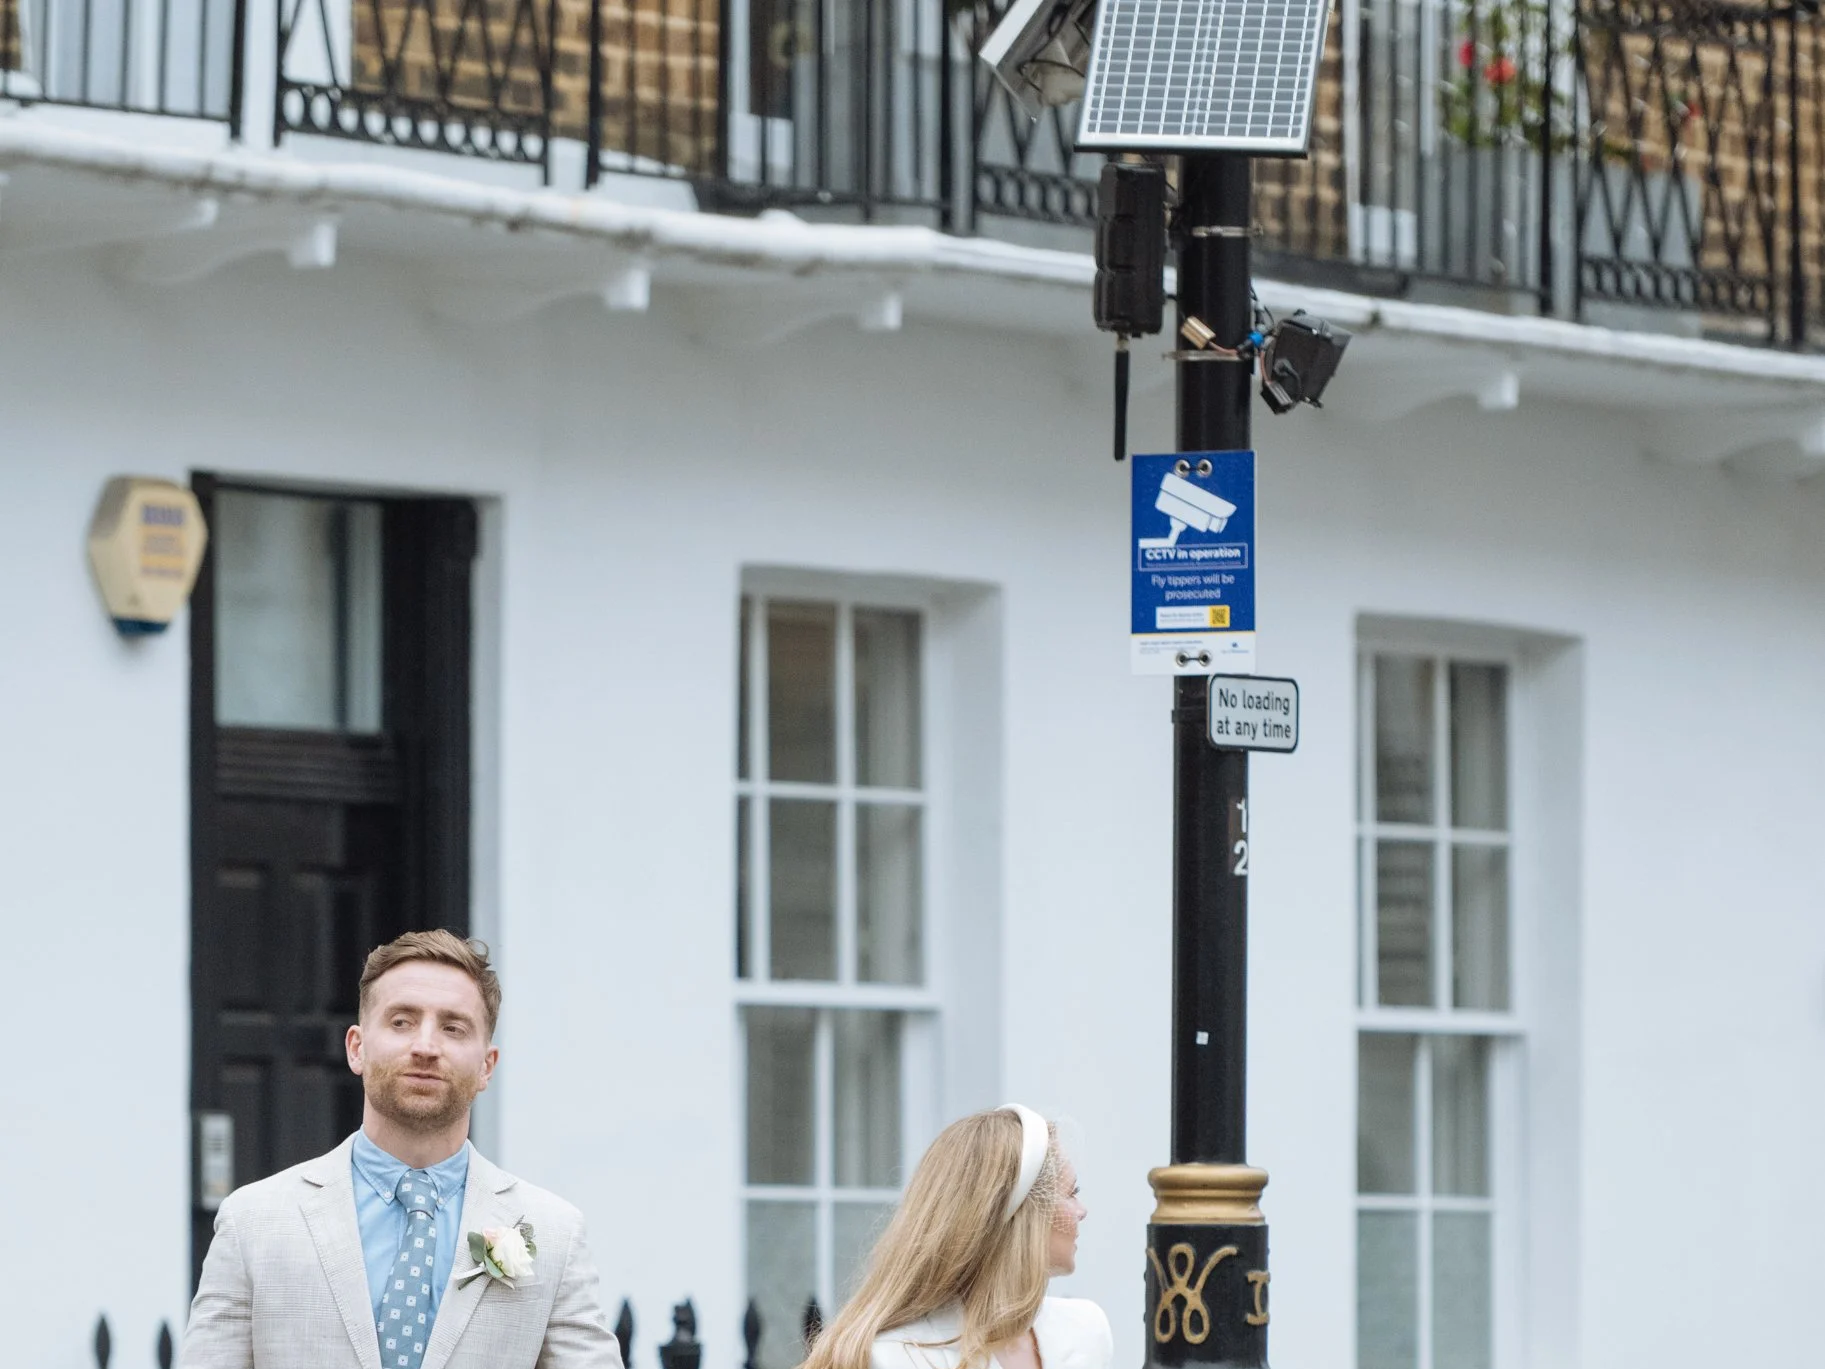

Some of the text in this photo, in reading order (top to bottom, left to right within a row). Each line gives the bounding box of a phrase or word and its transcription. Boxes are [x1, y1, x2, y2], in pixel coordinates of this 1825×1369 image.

[1145, 547, 1241, 561] CCTV in operation
[1151, 573, 1235, 588] Fly tippers will be
[1165, 588, 1221, 602] prosecuted
[1218, 688, 1290, 716] No loading
[1216, 716, 1292, 741] at any time
